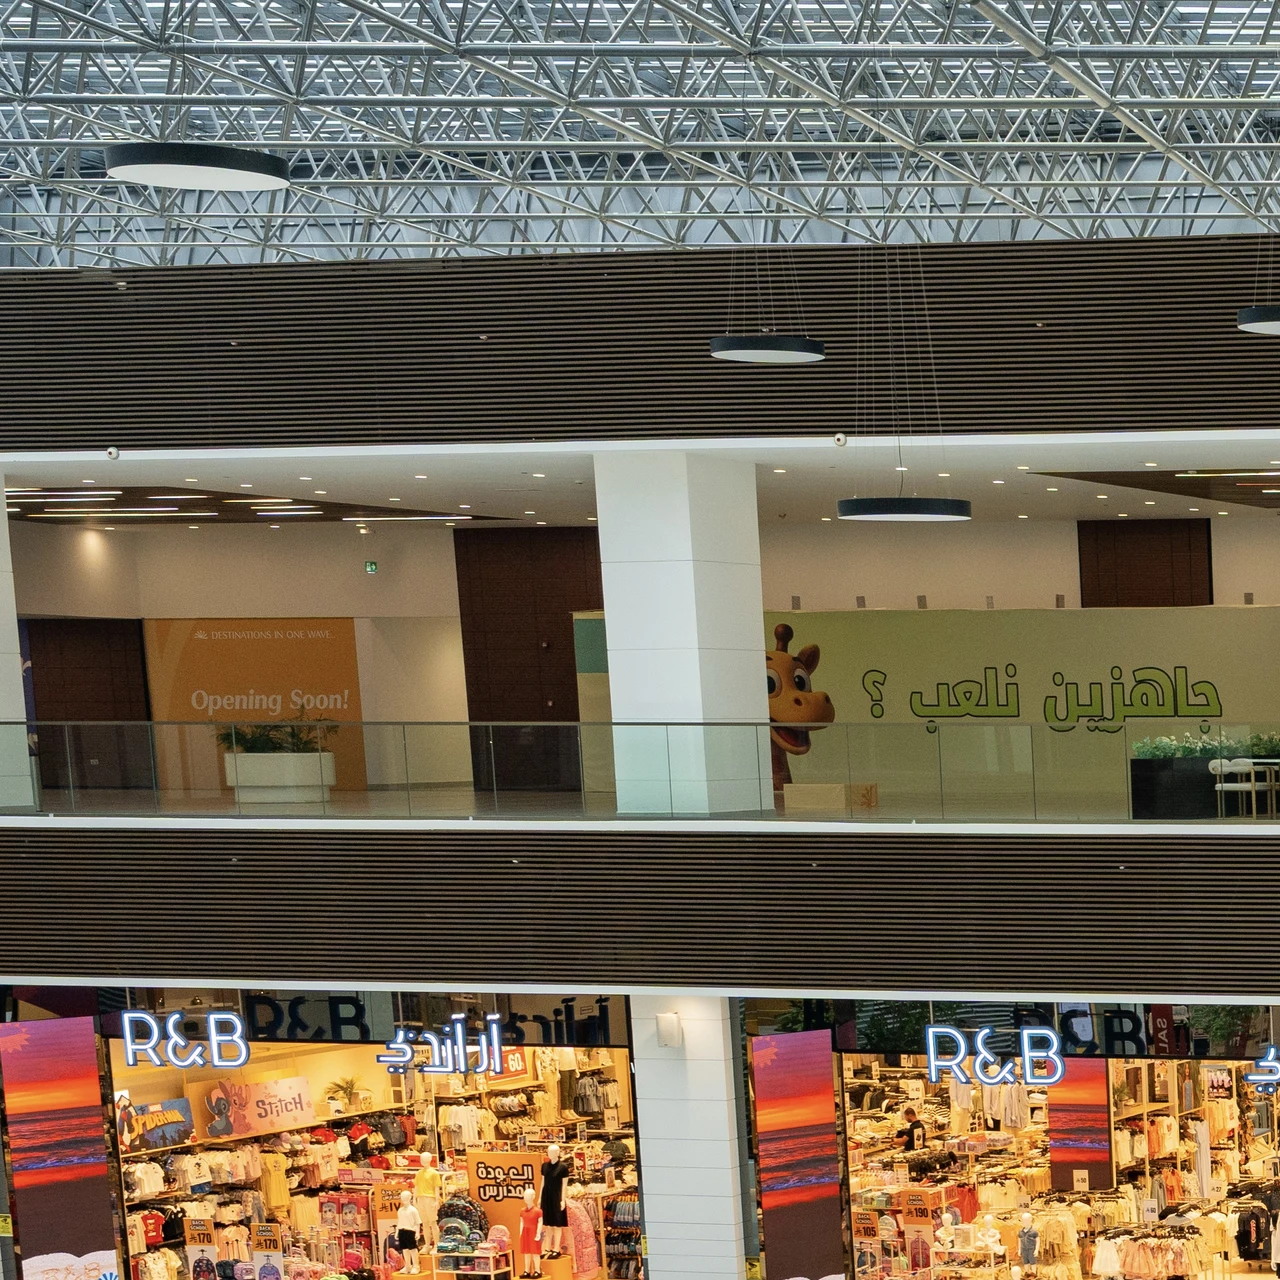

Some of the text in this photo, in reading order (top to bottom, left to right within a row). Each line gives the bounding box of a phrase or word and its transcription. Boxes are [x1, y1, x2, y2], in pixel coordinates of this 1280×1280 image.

[211, 631, 272, 640] DESTINATIONS
[274, 631, 284, 639] IN
[286, 630, 305, 639] ONE
[191, 689, 349, 716] Opening Soon!
[909, 663, 1020, 733] نلعب
[1043, 666, 1222, 733] جاهزين
[121, 1009, 250, 1070] R&B
[925, 1024, 1066, 1087] R&B
[477, 1162, 534, 1182] العودة
[913, 1207, 929, 1218] 190
[197, 1232, 213, 1244] 170
[862, 1226, 877, 1237] 105
[263, 1238, 279, 1250] 170
